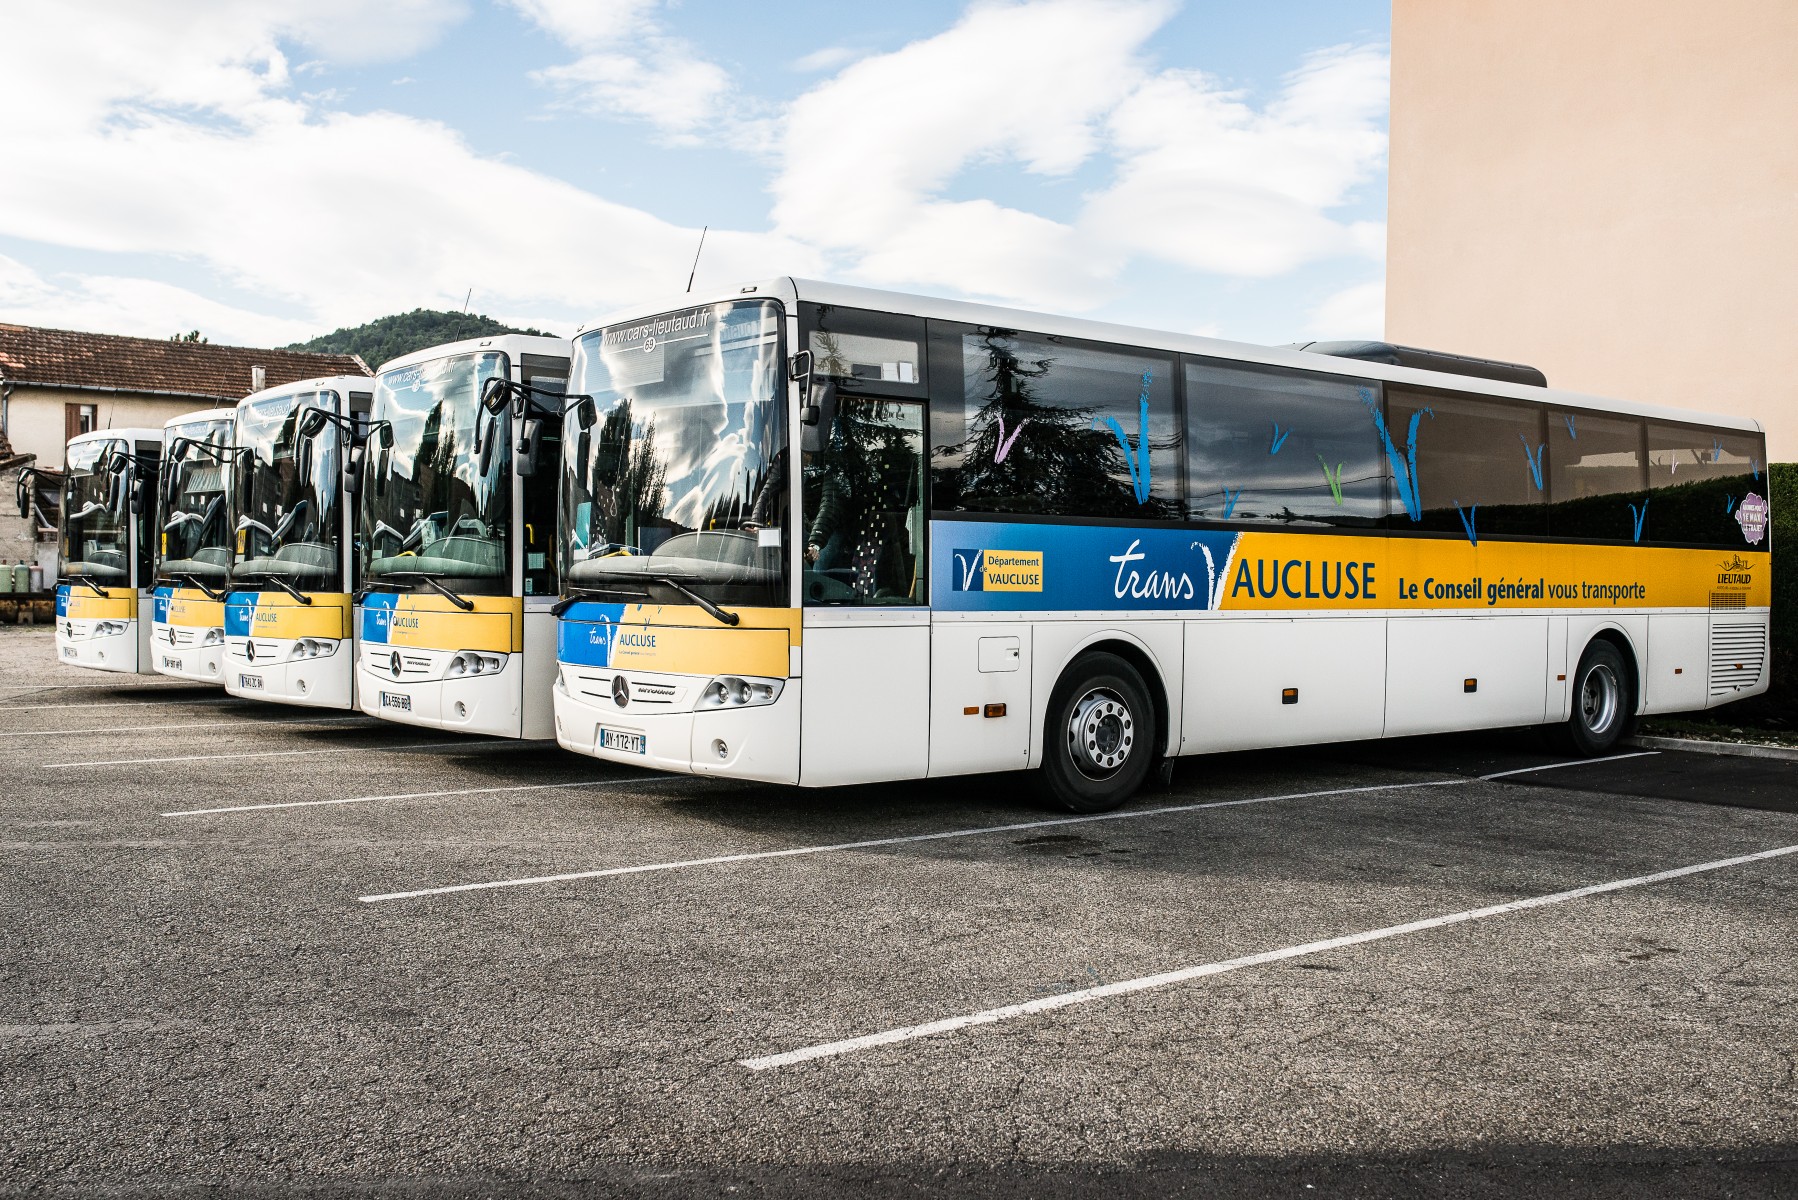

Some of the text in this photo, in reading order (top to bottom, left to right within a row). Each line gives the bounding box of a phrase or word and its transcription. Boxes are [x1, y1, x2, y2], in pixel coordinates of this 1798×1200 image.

[603, 308, 711, 346] www.cars-lieutaud.fr
[988, 556, 1040, 567] Département
[989, 574, 1040, 585] VAUCLUSE
[1109, 539, 1194, 600] trans
[1399, 577, 1418, 599] Le
[1423, 577, 1482, 599] Conseil
[1487, 577, 1544, 606] général
[1548, 584, 1578, 599] vous
[1582, 581, 1645, 605] transporte
[1717, 574, 1752, 584] LIEUTAUD
[605, 732, 639, 751] AY-172-YT
